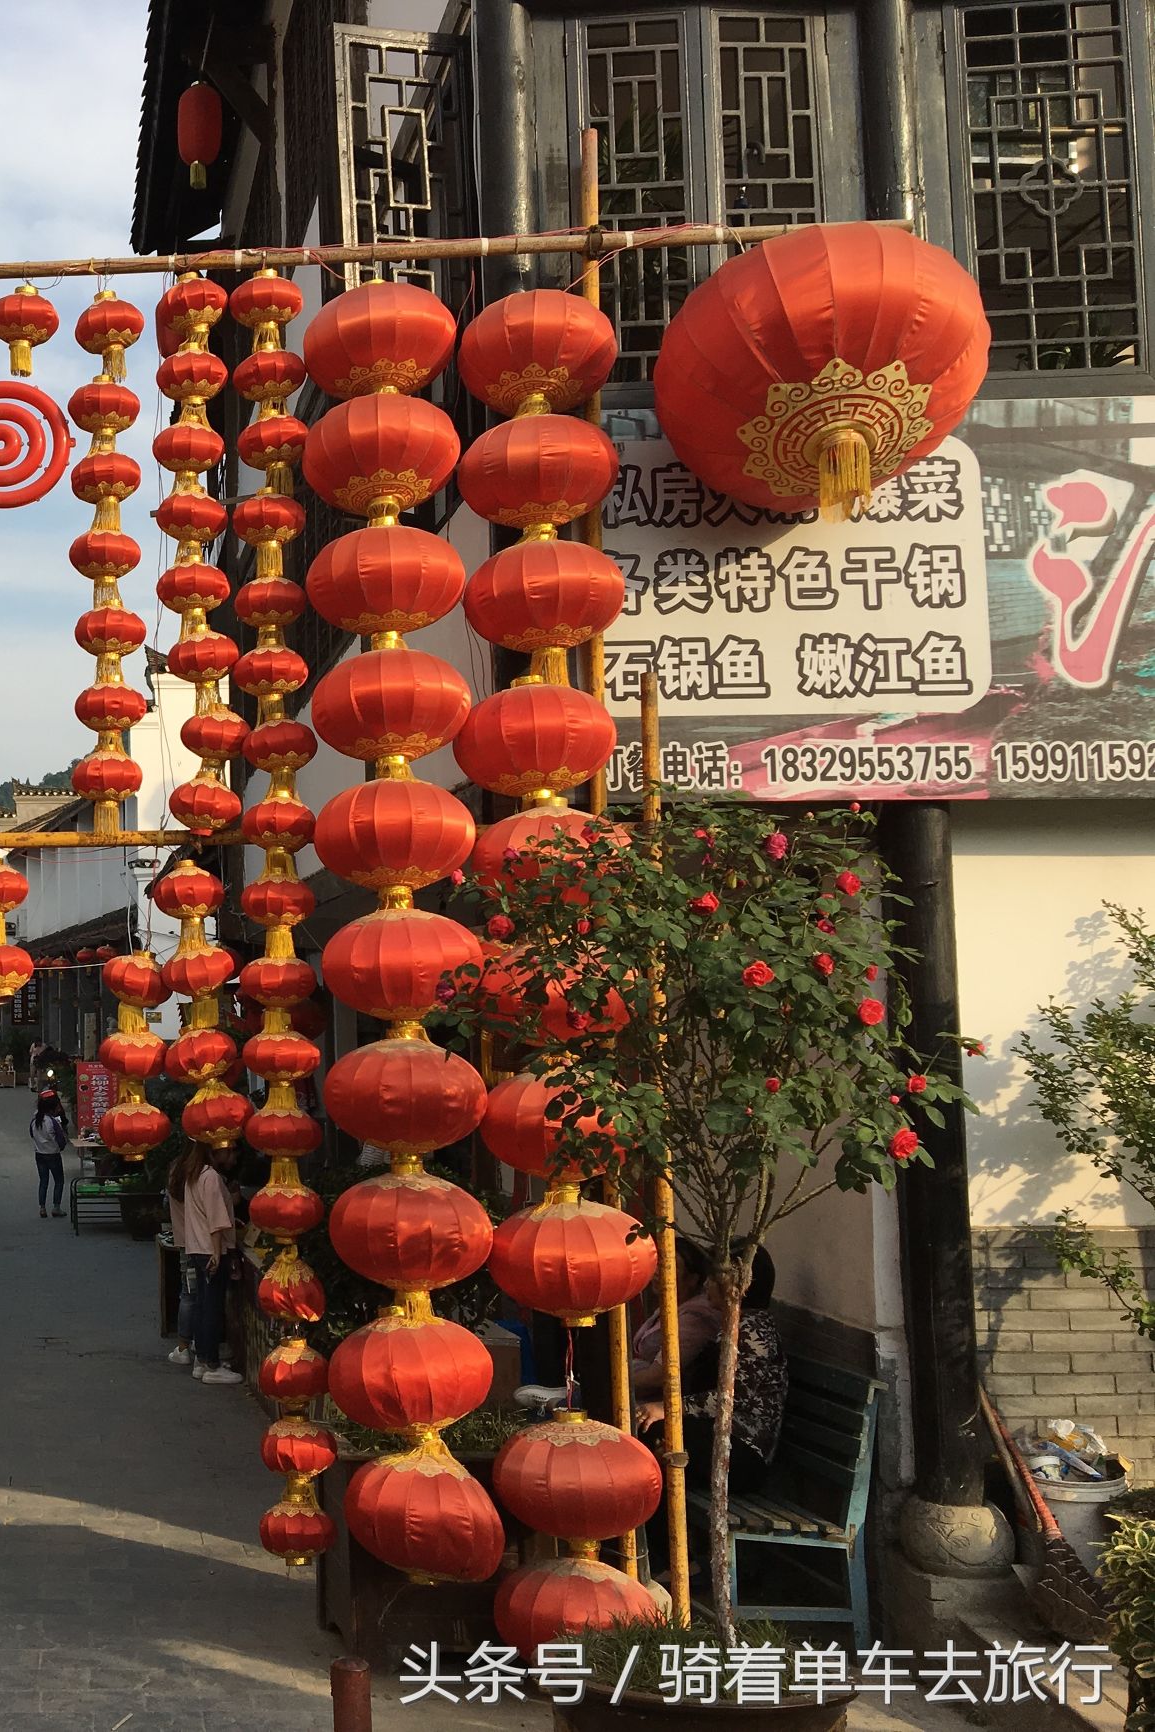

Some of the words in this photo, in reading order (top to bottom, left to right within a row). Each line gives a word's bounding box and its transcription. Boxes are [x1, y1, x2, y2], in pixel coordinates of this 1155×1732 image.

[601, 463, 820, 526] 私房
[606, 544, 968, 613] 各类特色干锅
[605, 636, 768, 699] 石锅鱼
[797, 632, 971, 697] 嫩江鱼
[761, 744, 973, 785] 18329553755
